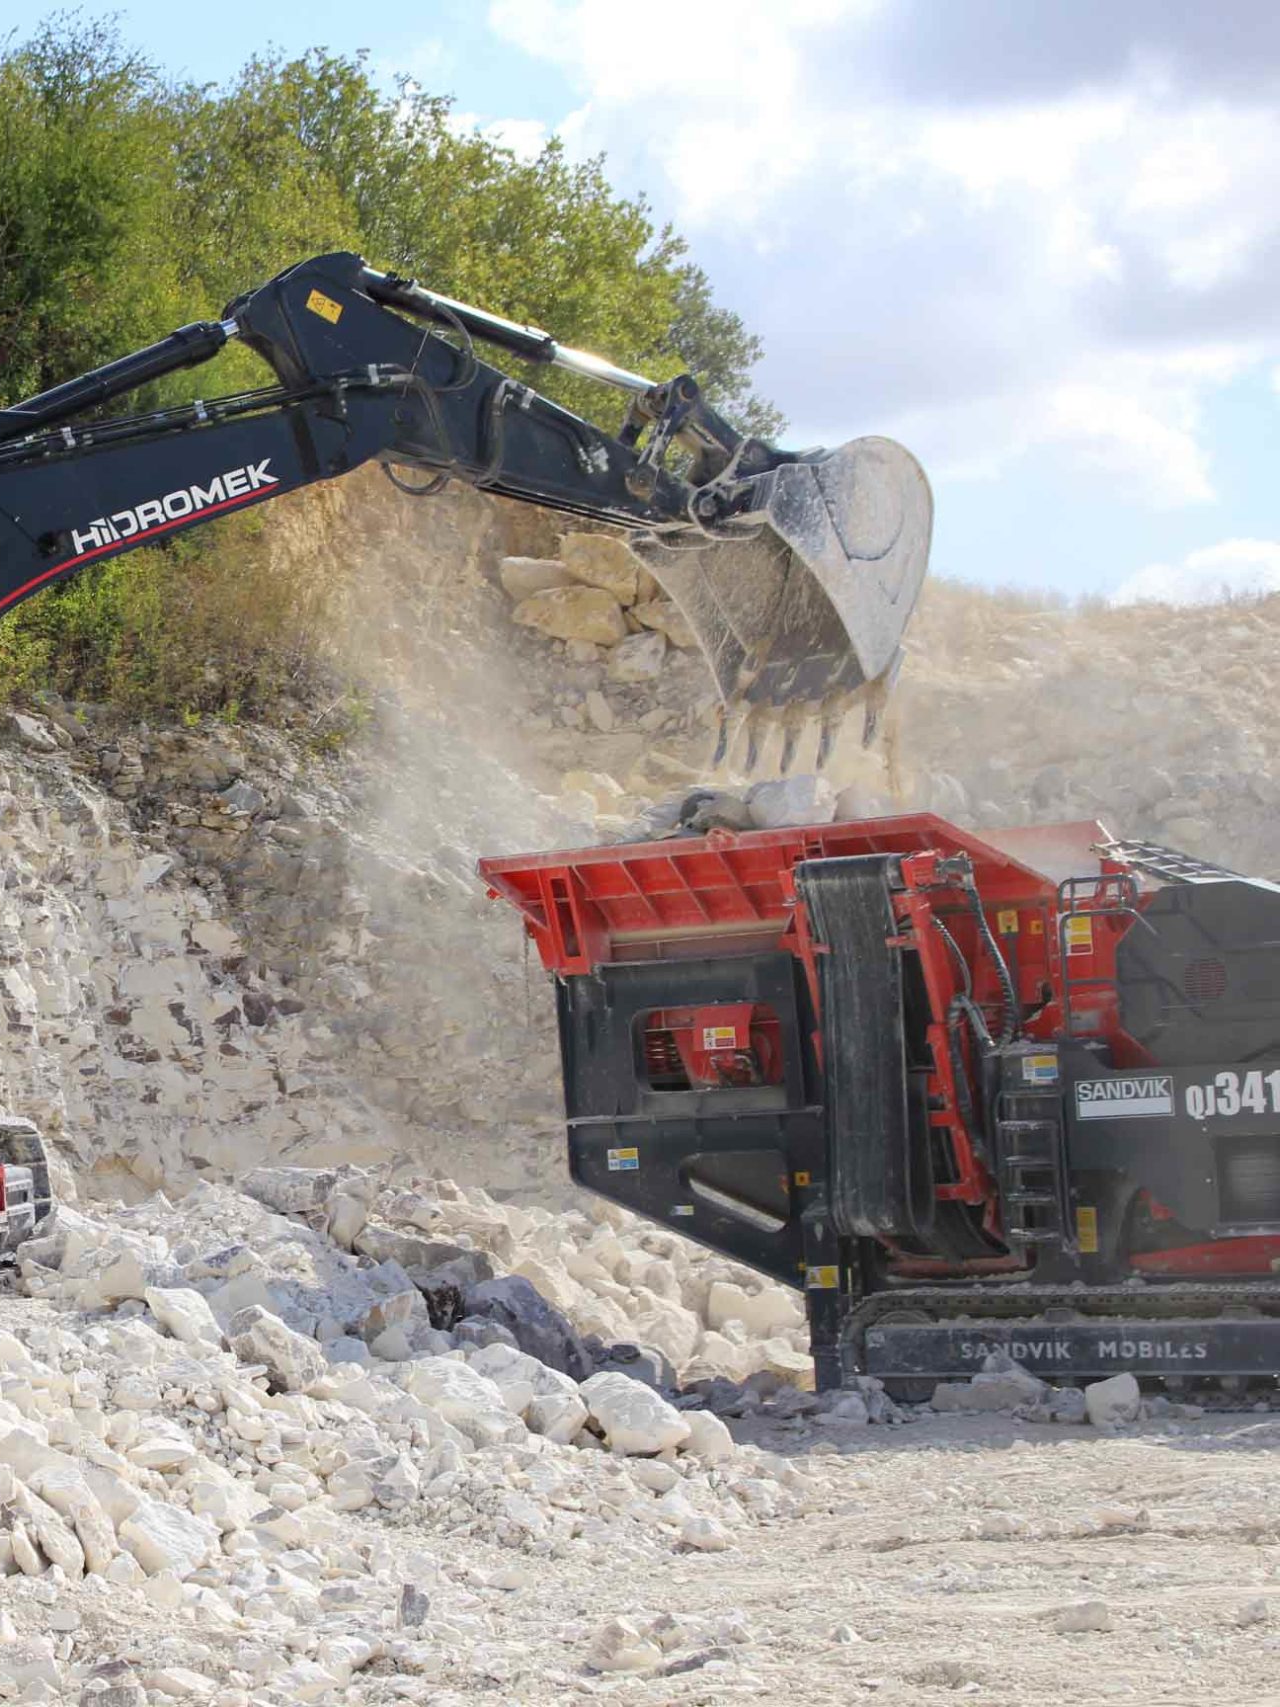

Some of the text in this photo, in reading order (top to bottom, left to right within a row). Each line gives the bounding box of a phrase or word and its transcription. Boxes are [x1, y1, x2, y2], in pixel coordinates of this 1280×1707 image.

[1078, 1078, 1170, 1101] SANDVIK
[1185, 1069, 1280, 1120] QJ341
[1098, 1340, 1207, 1359] MOBILES
